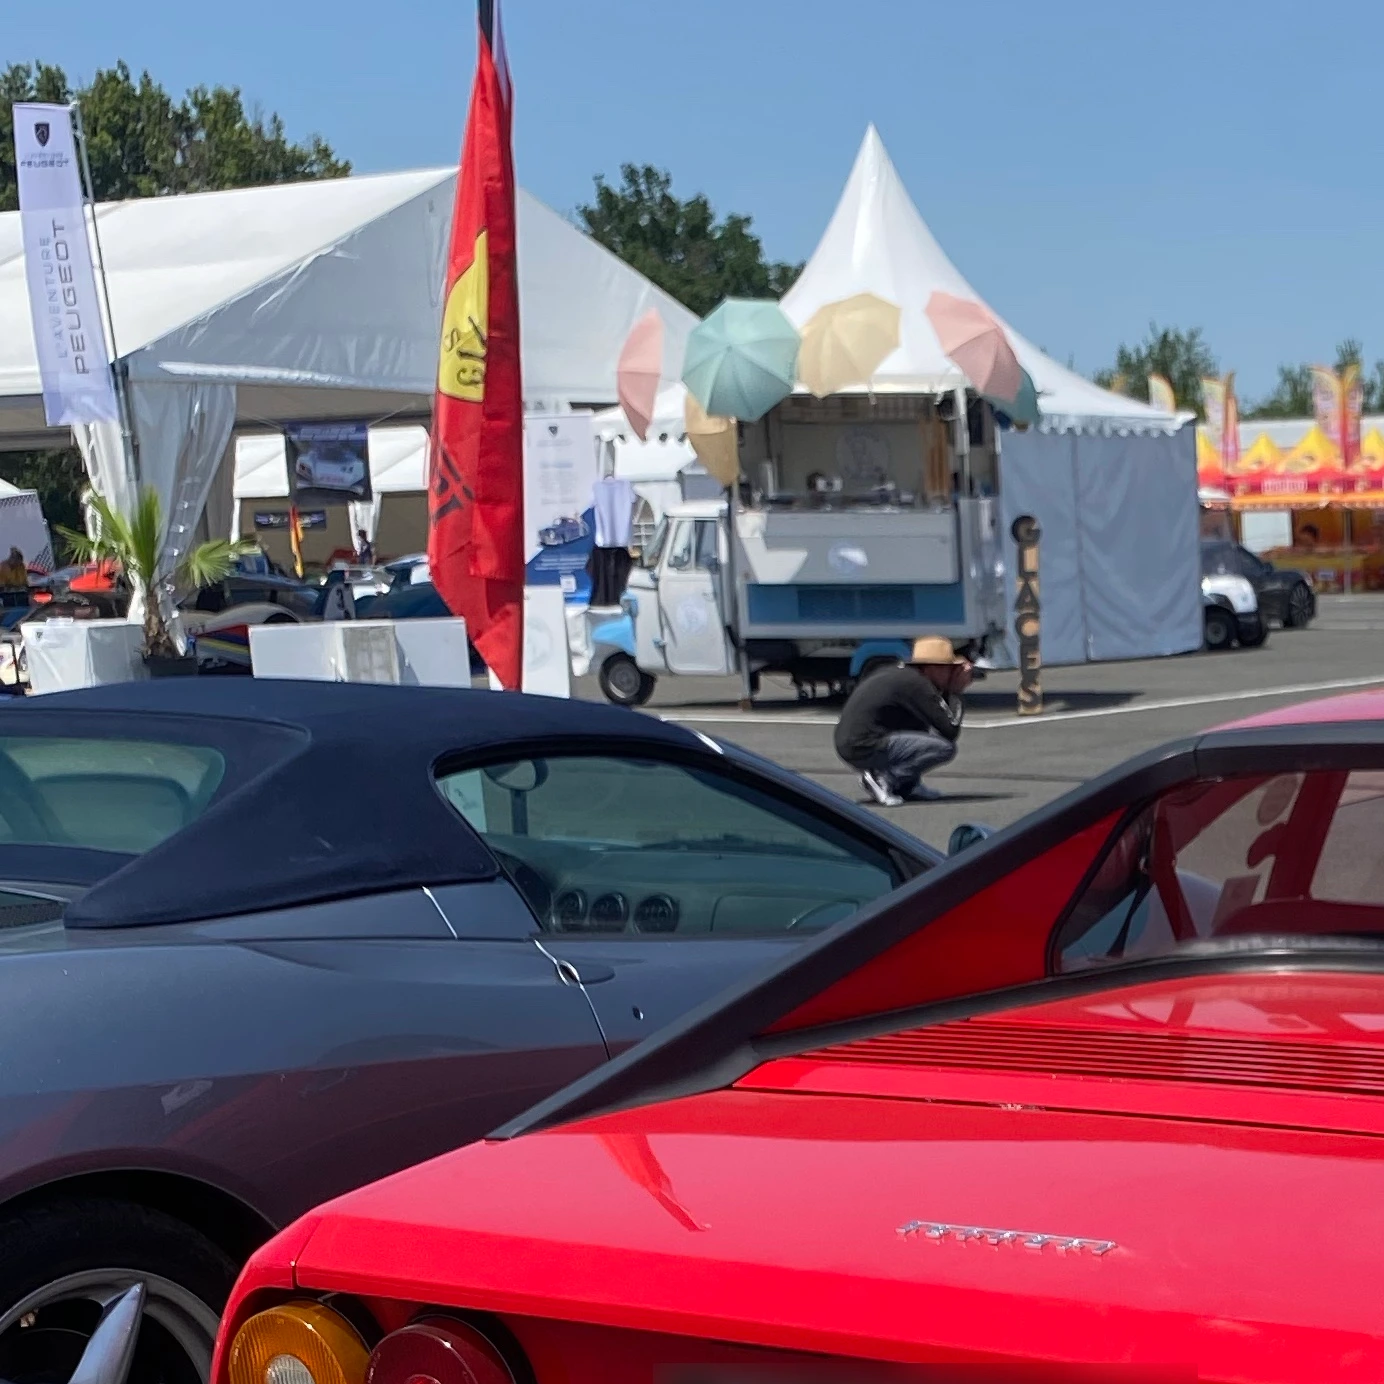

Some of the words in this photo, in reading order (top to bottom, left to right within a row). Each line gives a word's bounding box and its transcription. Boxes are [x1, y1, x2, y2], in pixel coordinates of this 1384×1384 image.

[39, 236, 68, 359] L'AVENTURE
[52, 218, 90, 375] PEUGEOT
[1012, 516, 1043, 709] GLACES
